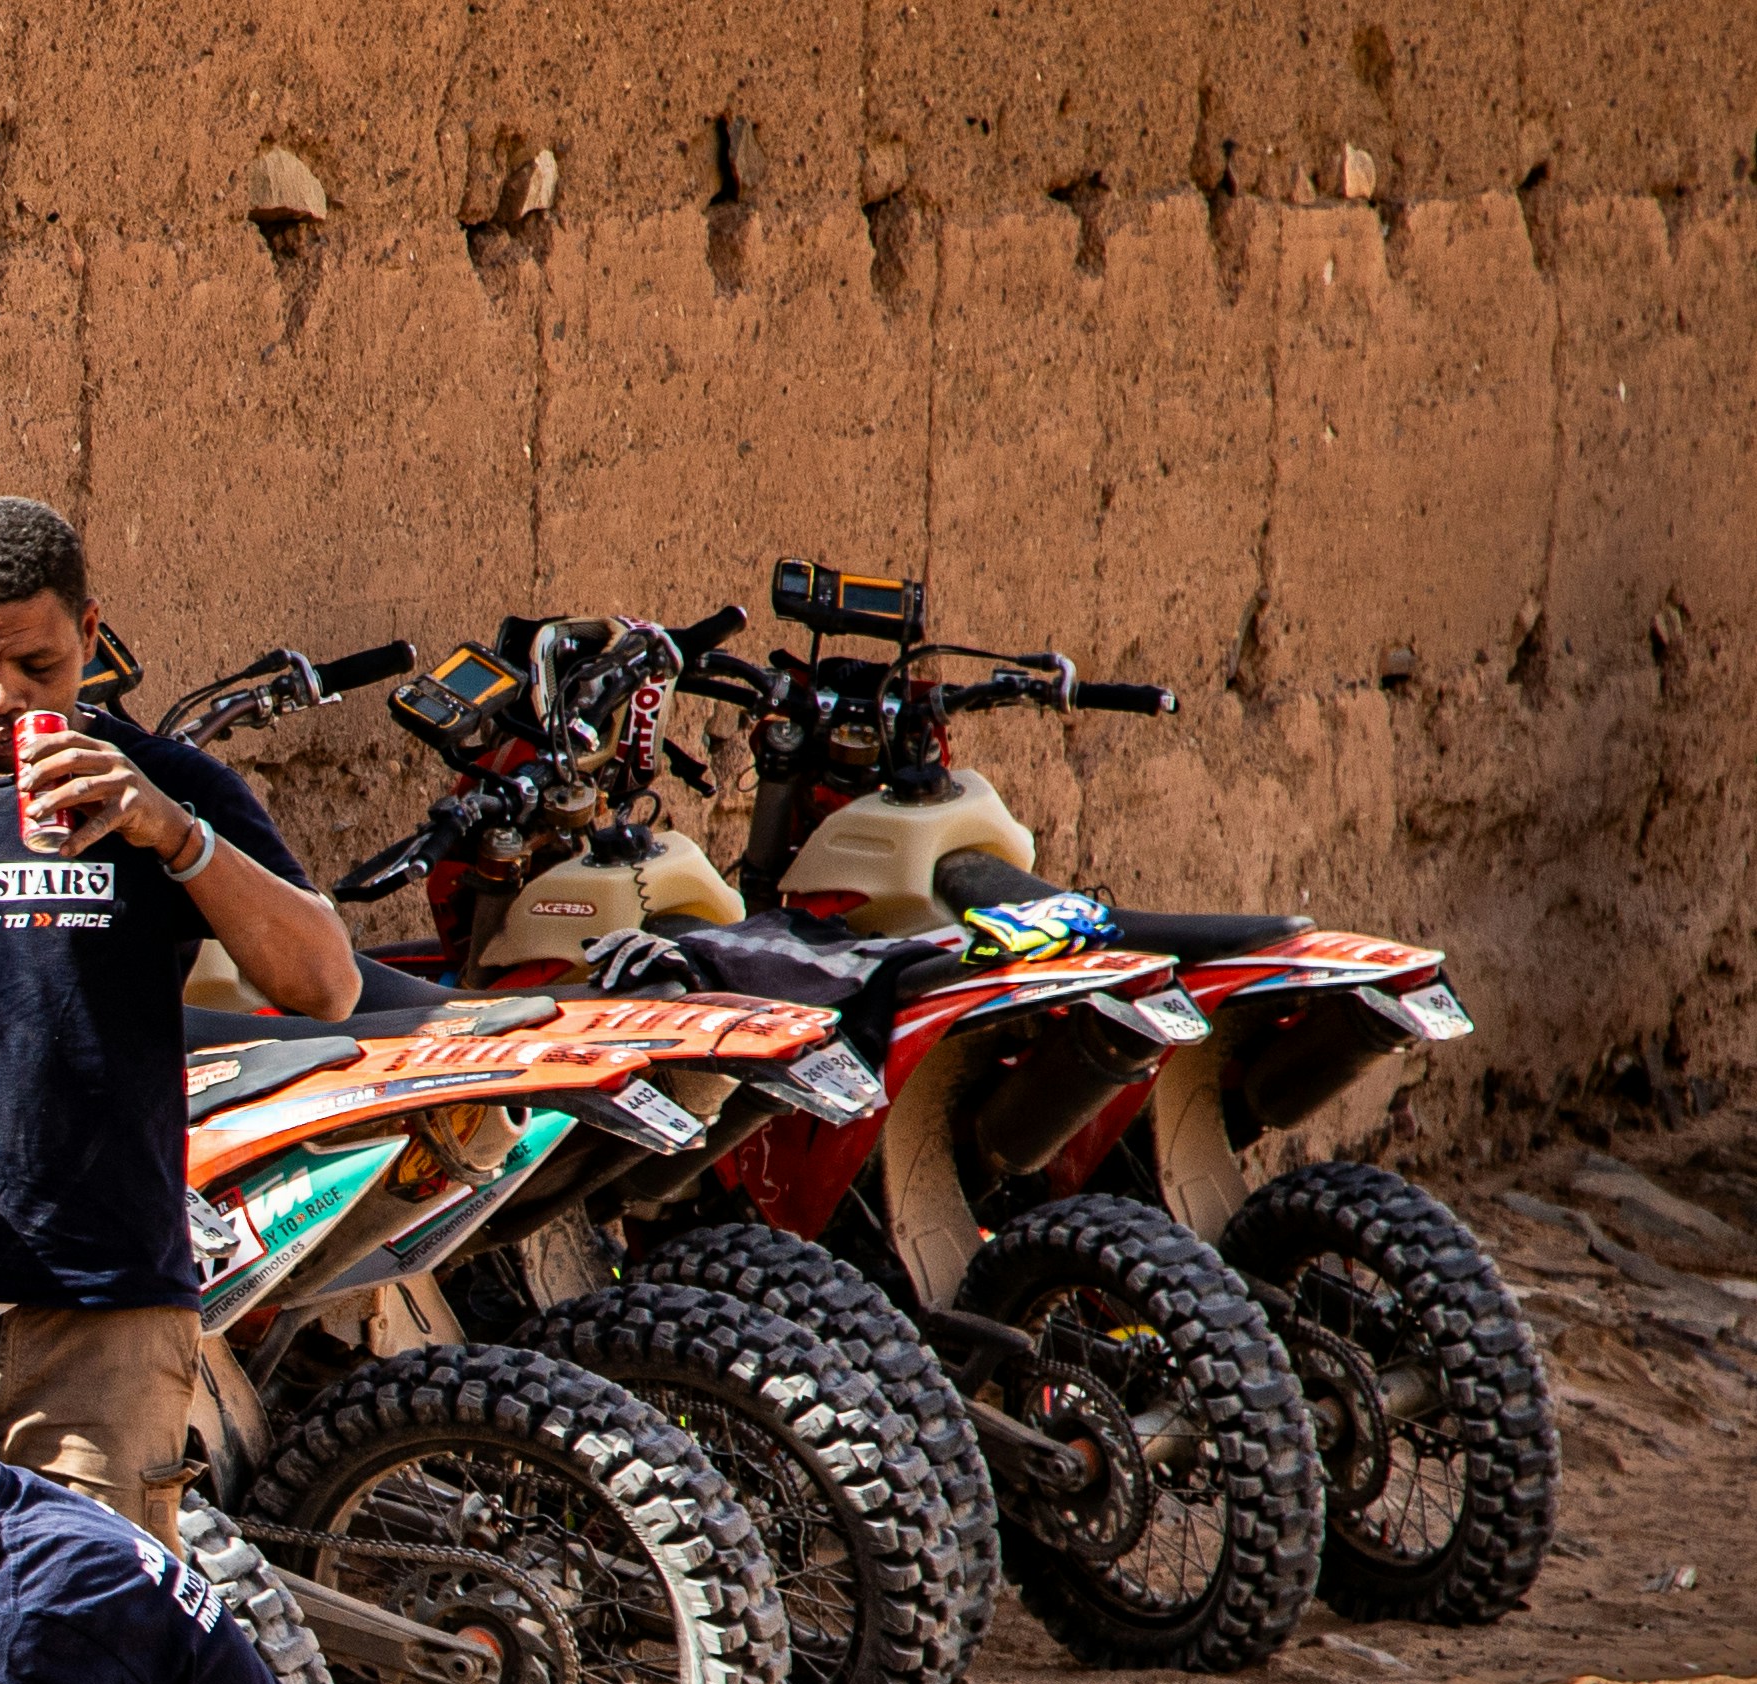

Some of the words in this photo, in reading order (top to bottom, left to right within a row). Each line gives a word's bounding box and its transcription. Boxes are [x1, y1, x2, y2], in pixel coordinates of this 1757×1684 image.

[531, 902, 596, 916] ACERBIS
[4, 913, 31, 929] TO
[56, 913, 113, 928] RACE
[1162, 998, 1186, 1014] 80
[335, 1088, 376, 1108] STAR
[627, 1087, 660, 1111] 4432
[506, 1140, 533, 1167] ACE
[279, 1219, 299, 1237] TO
[305, 1186, 344, 1219] RACE
[398, 1188, 497, 1273] marruecosenmoto.es
